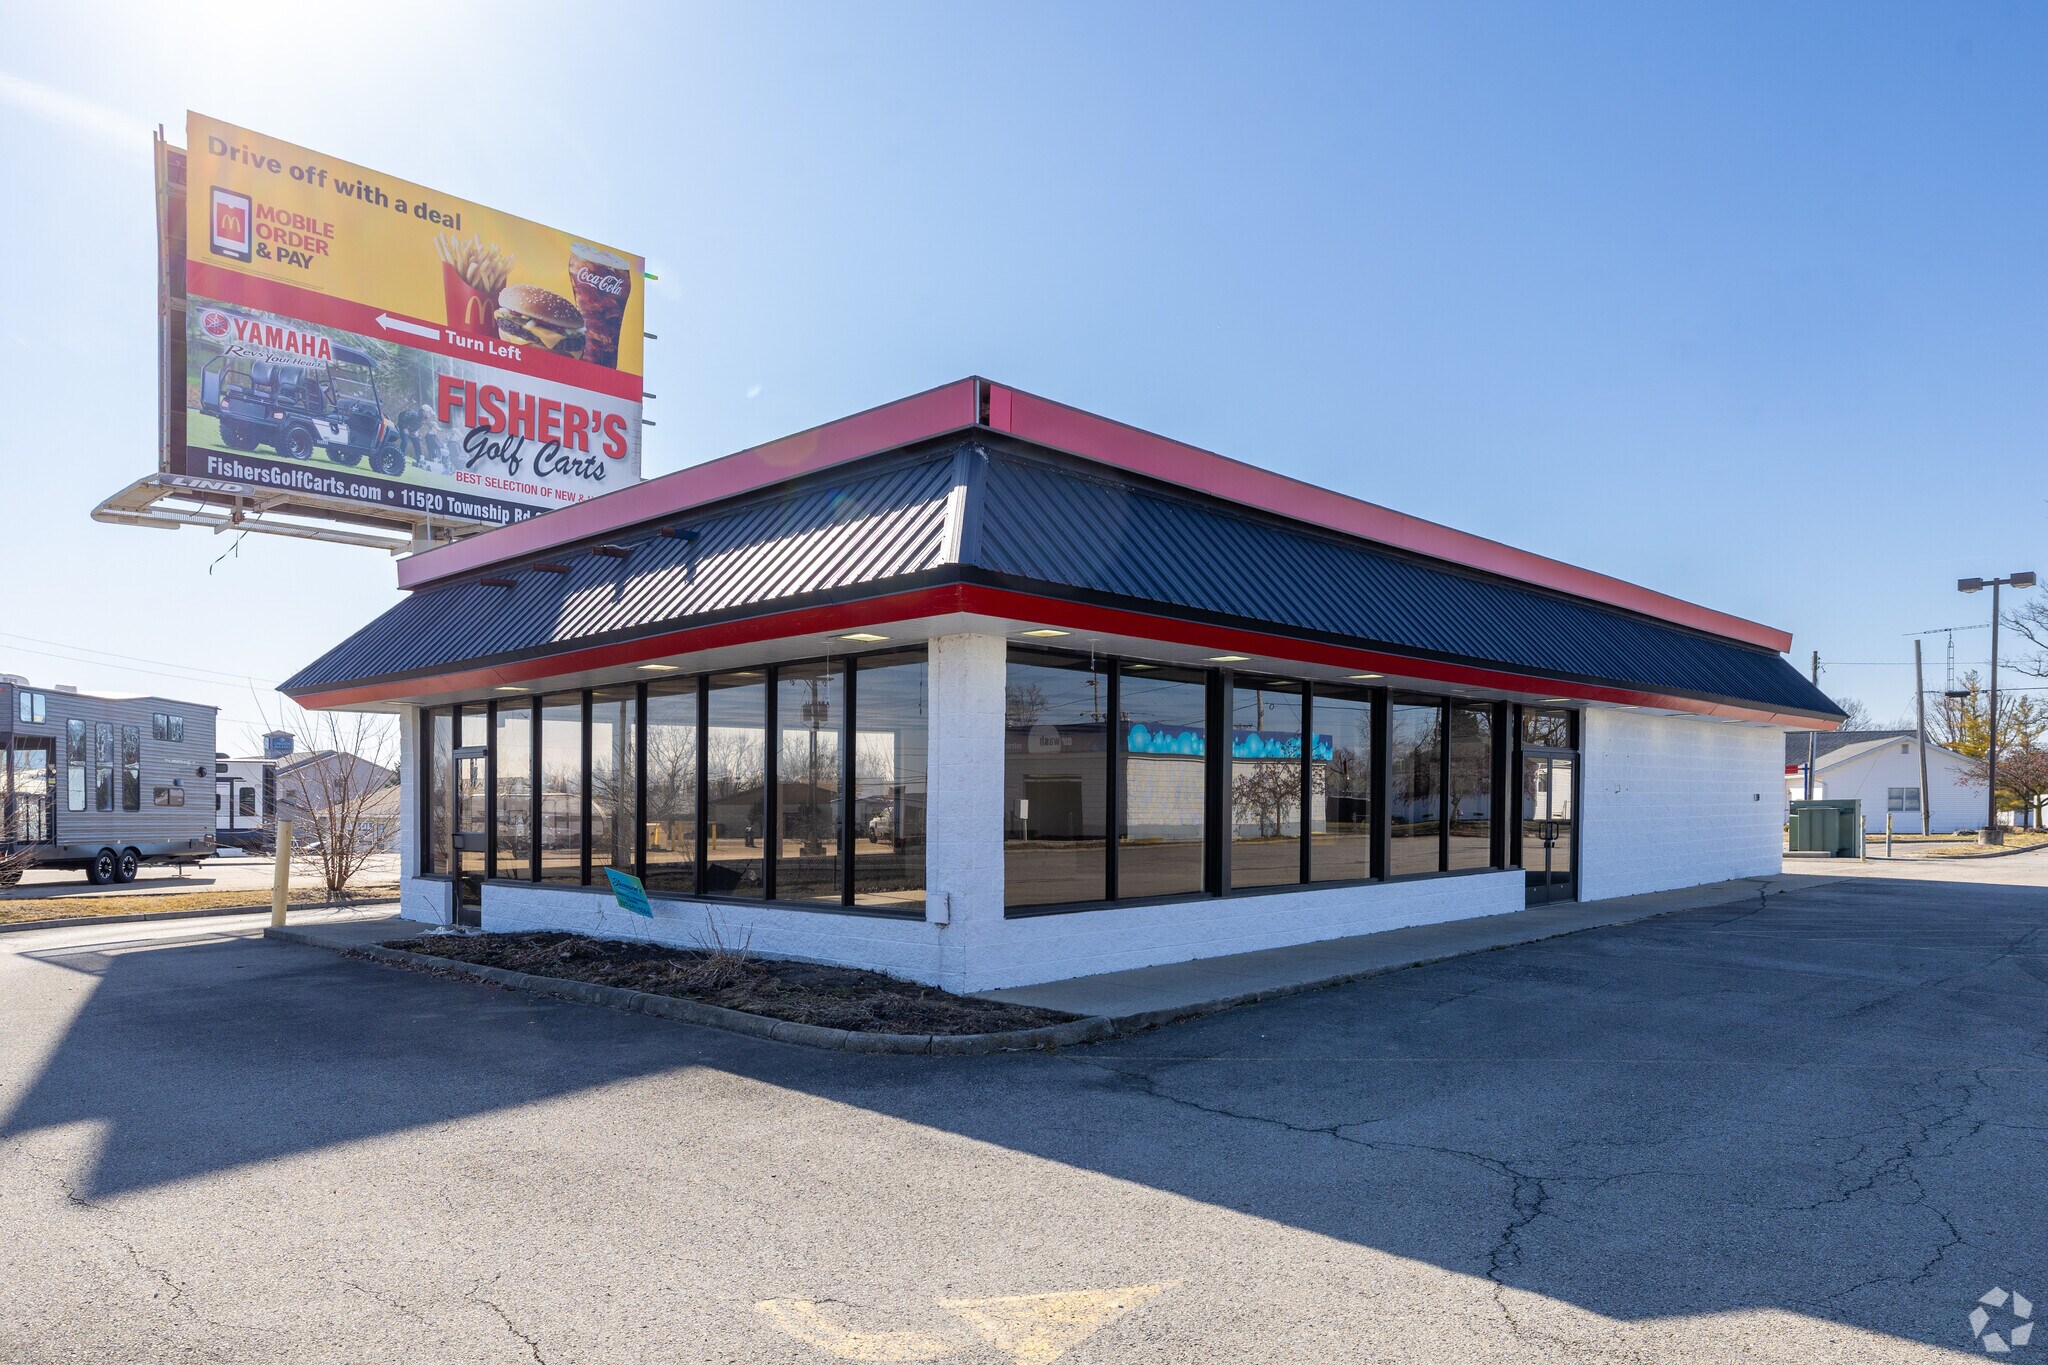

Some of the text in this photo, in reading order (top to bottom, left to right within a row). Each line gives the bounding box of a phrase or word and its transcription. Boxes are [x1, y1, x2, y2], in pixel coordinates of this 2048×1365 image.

[208, 135, 461, 231] Drive off with a deal
[255, 203, 335, 240] MOBILE
[255, 223, 330, 257] ORDER
[255, 241, 314, 270] & PAY
[576, 266, 624, 296] Coca-Cola
[233, 317, 333, 361] YAMAHA
[445, 329, 522, 362] Turn Left
[224, 344, 324, 369] Revs Your Heart
[437, 373, 628, 460] FISHER'S
[463, 424, 607, 482] Golf Carts
[171, 476, 244, 493] LIND
[207, 455, 382, 501] FishersGolfCarts.com
[401, 488, 443, 511] 11520
[446, 496, 510, 525] Township
[456, 471, 482, 486] BEST
[484, 476, 538, 496] SELECTION
[540, 486, 553, 498] OF
[555, 489, 577, 502] NEW
